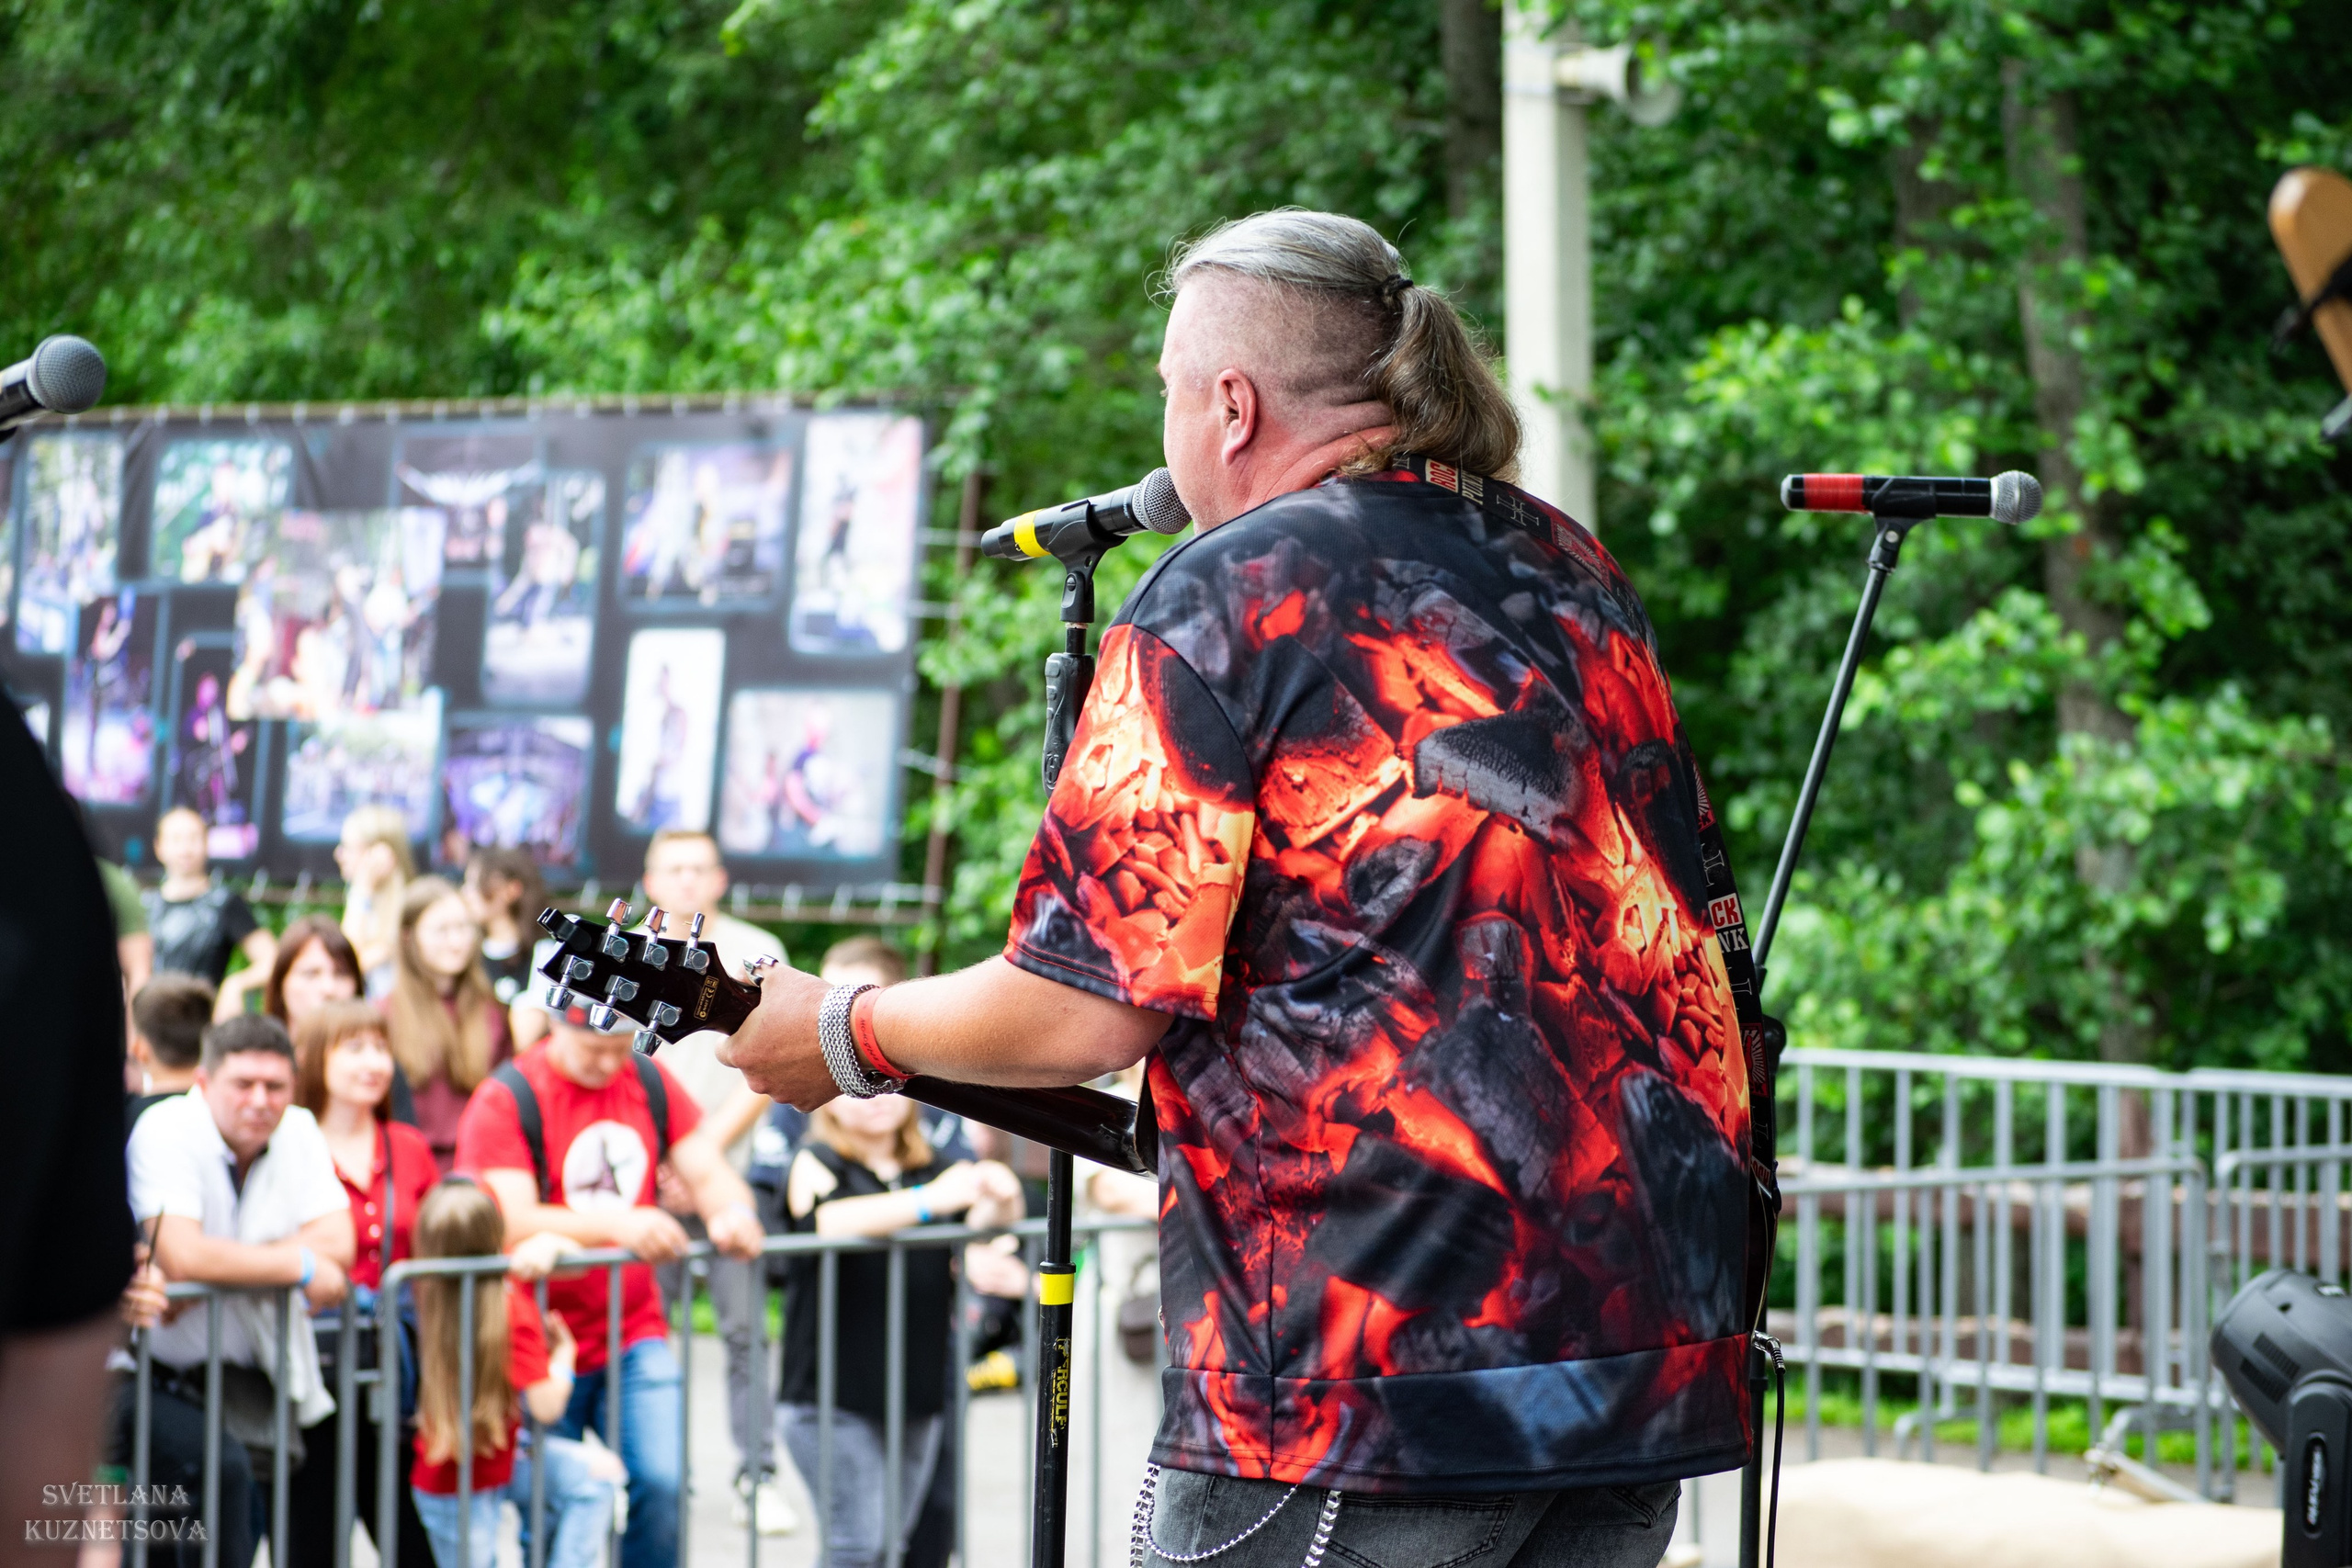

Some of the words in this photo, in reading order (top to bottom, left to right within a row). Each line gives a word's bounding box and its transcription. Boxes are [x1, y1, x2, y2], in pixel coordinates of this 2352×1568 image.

[1430, 461, 1457, 491] ROC
[1711, 897, 1739, 927] CK
[1716, 927, 1749, 953] NK
